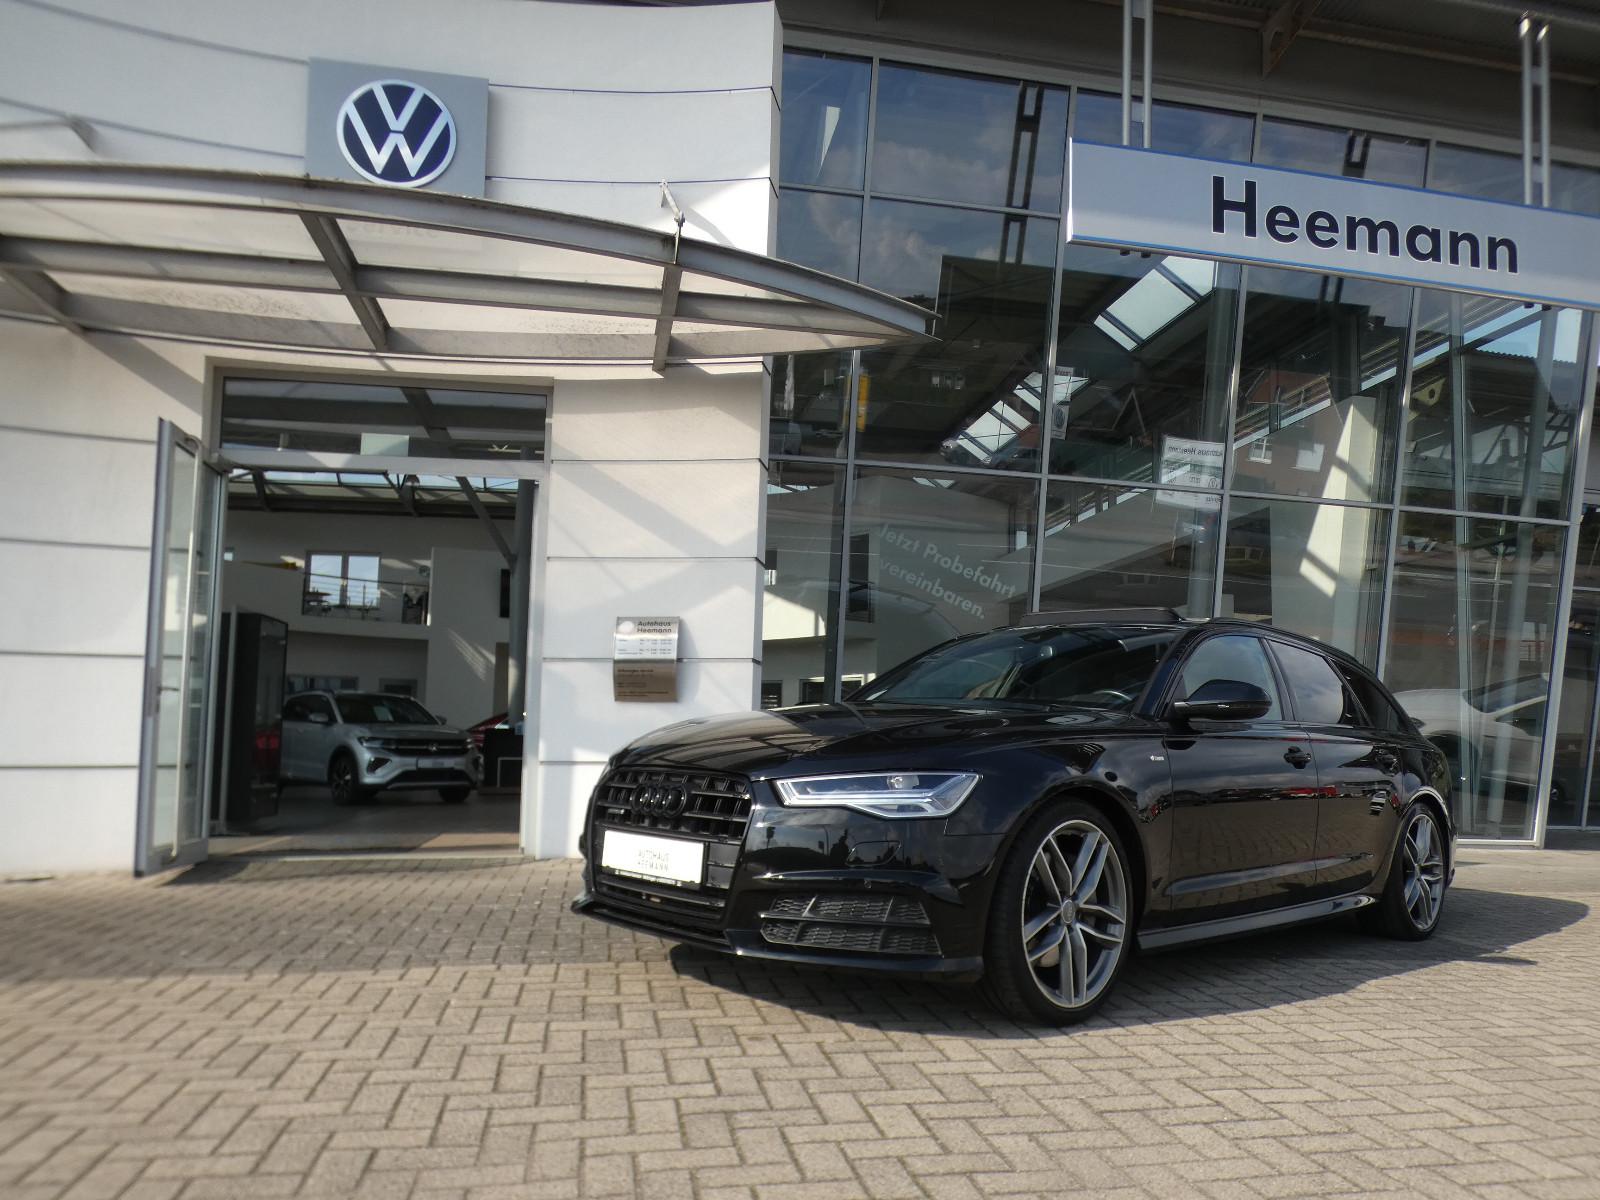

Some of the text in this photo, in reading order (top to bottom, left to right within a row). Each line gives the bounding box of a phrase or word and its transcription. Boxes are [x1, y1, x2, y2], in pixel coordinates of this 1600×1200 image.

[337, 79, 456, 188] VW
[1212, 175, 1518, 274] Heemann
[879, 523, 1016, 598] Jetzt Probefahrt
[880, 559, 985, 619] vereinbaren.
